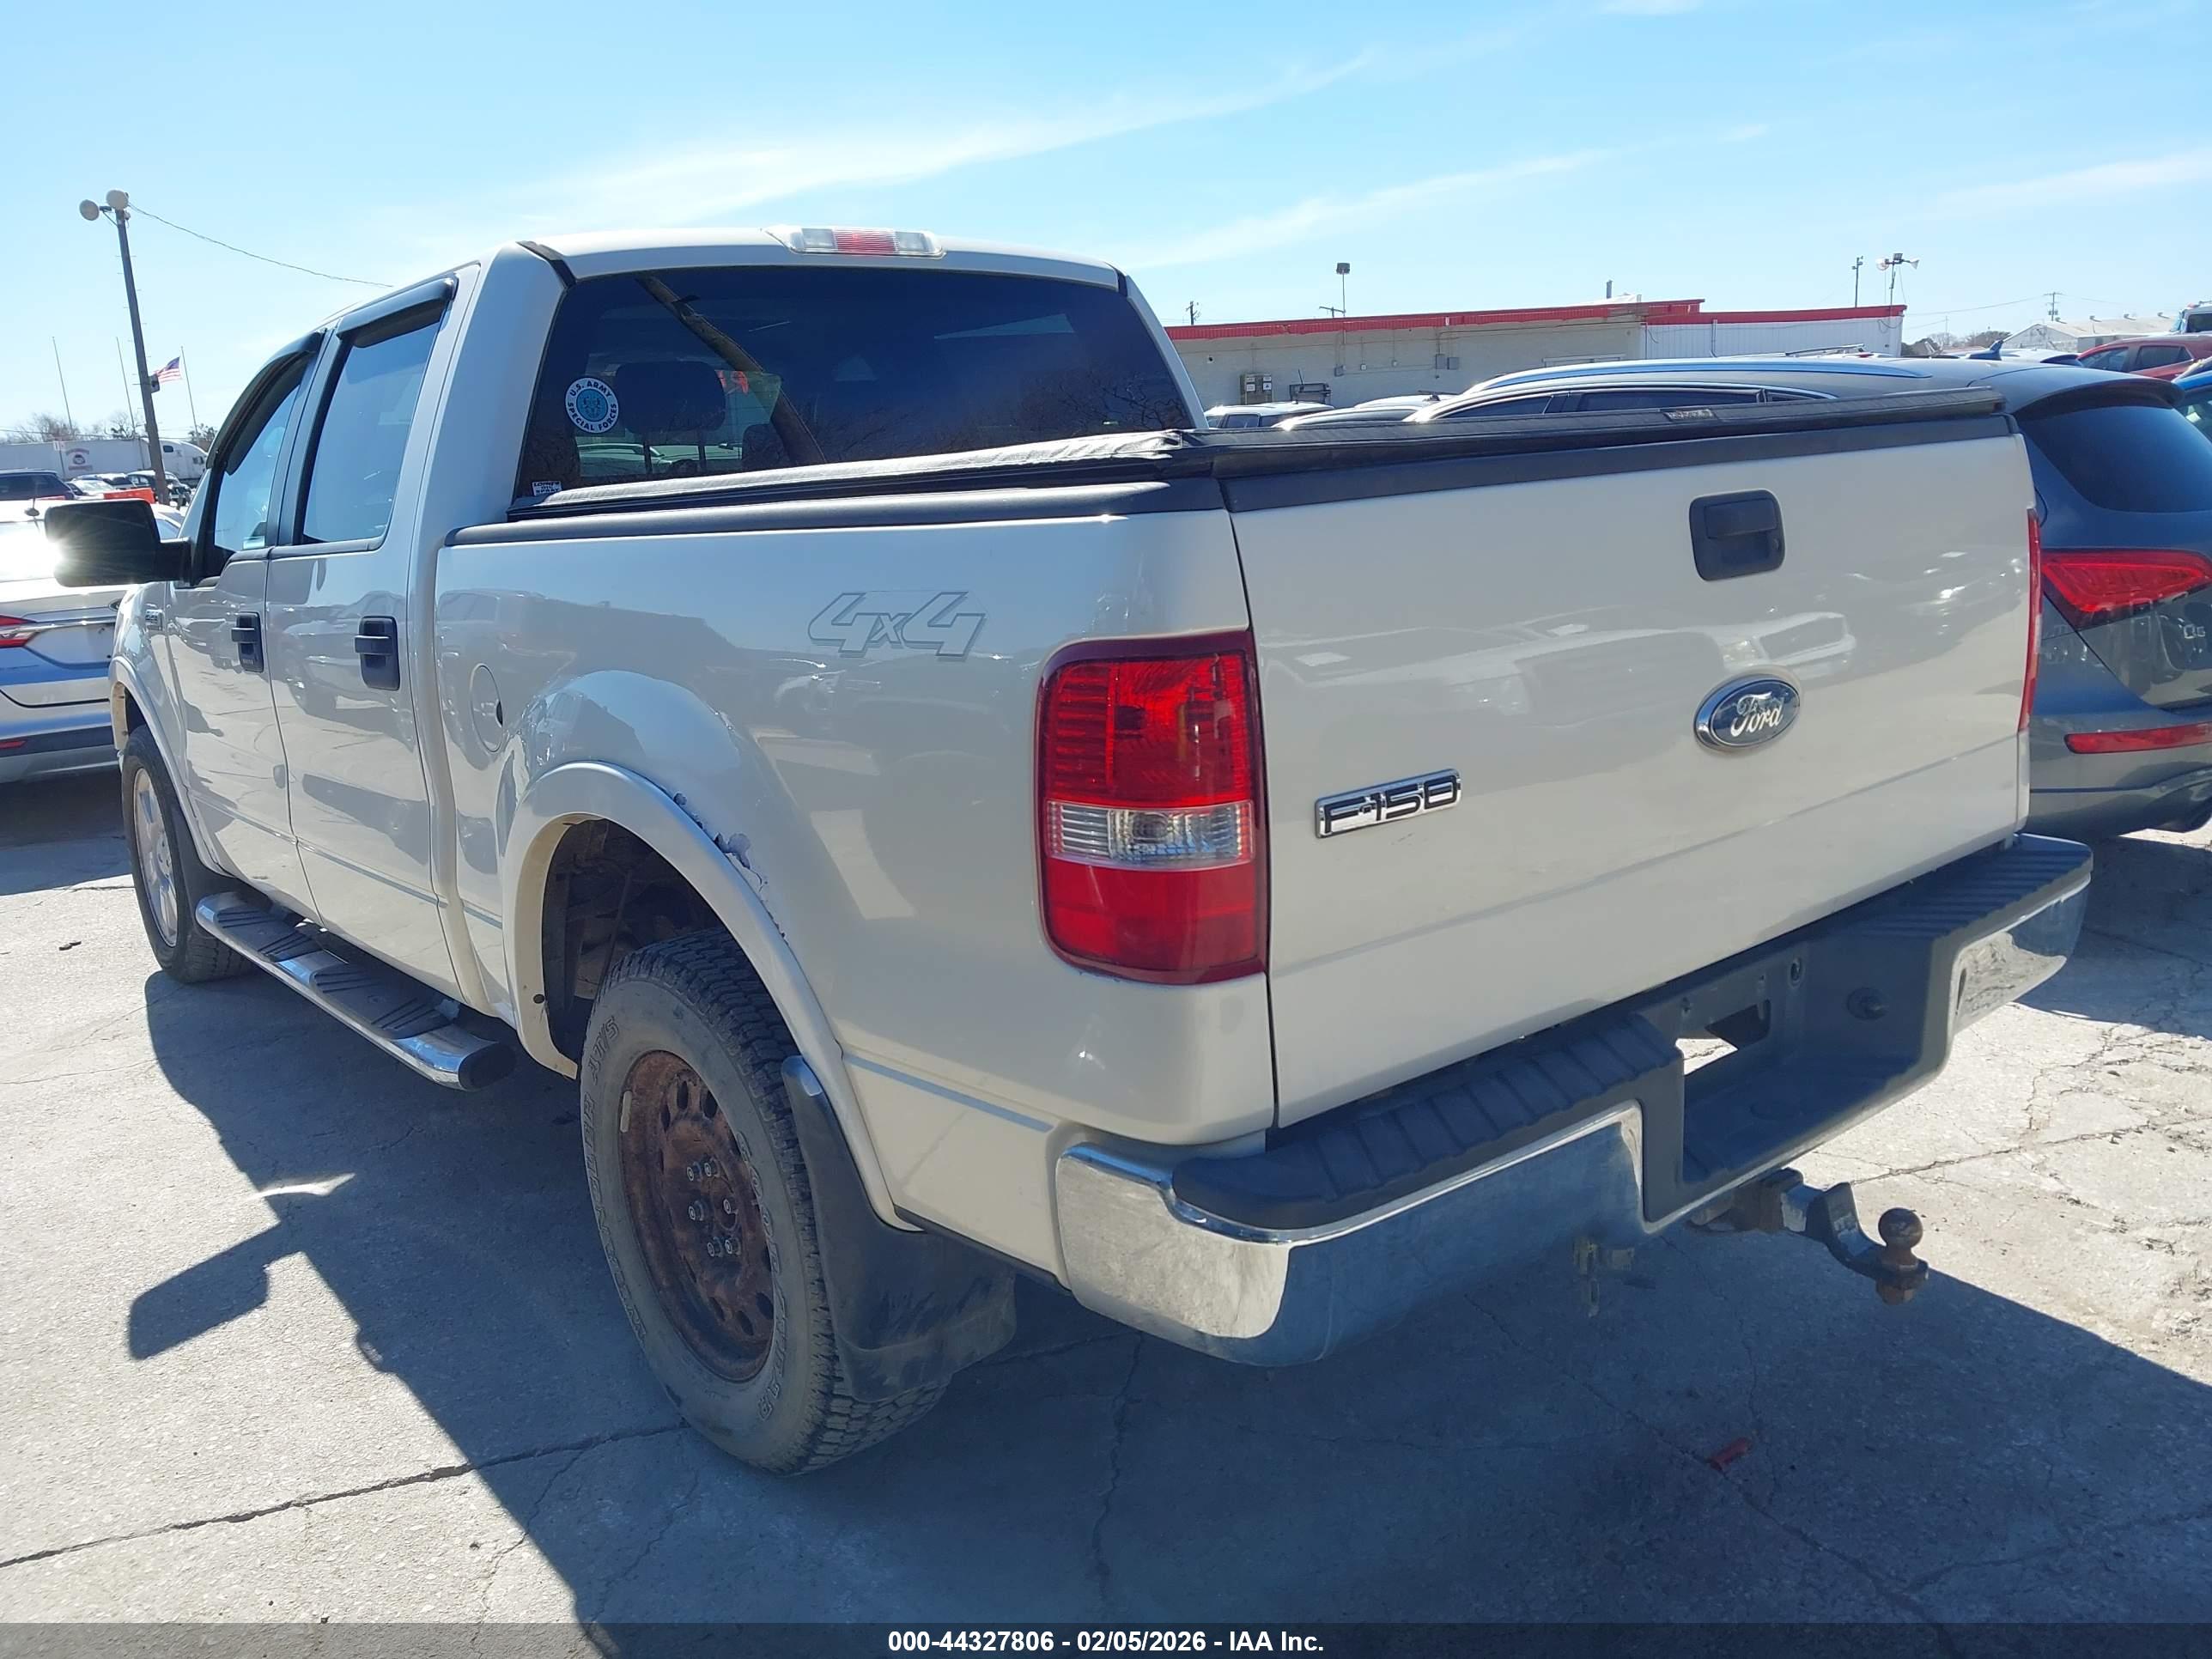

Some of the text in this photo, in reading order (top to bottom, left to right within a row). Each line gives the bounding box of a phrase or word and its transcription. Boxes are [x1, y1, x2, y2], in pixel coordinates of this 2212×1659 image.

[570, 380, 612, 398] U.S. ARMY
[568, 401, 617, 431] SPECIAL FORCES
[807, 590, 988, 659] 4x4
[1729, 690, 1784, 738] Ford
[1323, 774, 1458, 835] F-150
